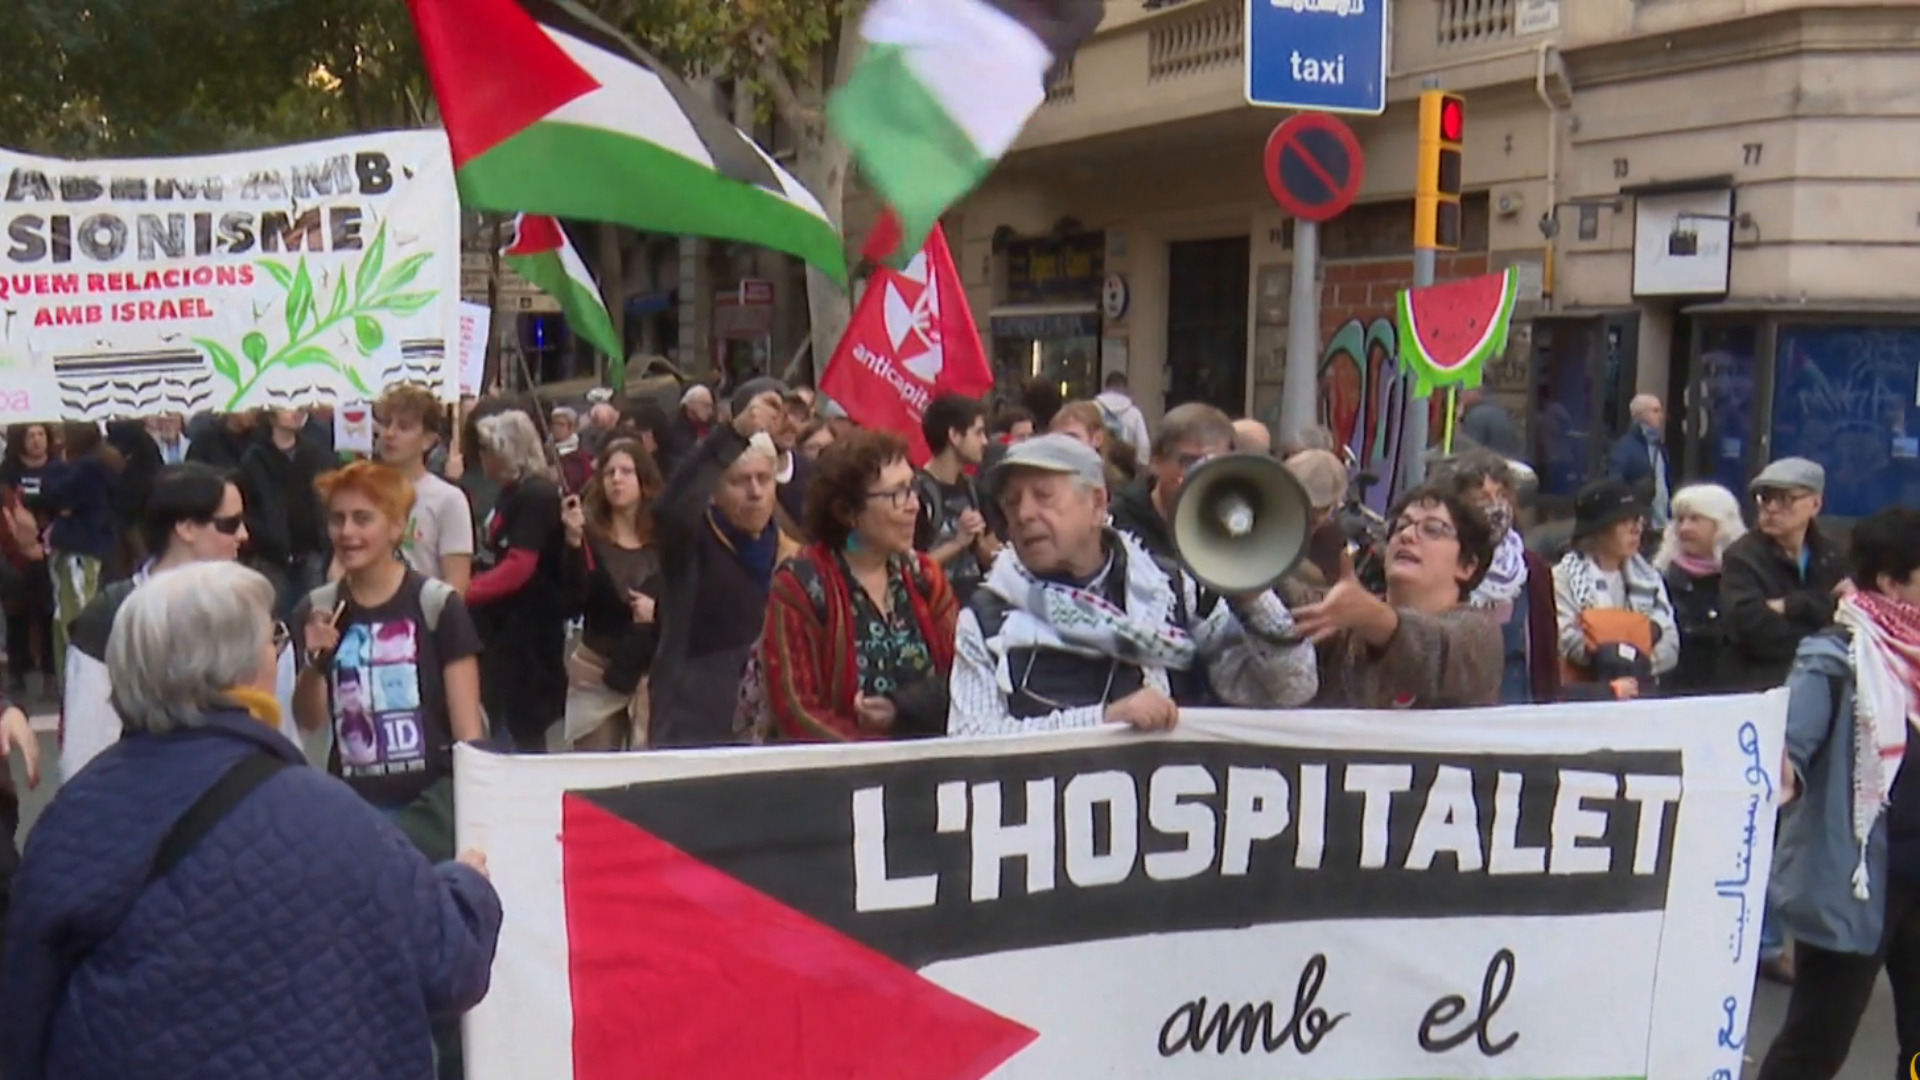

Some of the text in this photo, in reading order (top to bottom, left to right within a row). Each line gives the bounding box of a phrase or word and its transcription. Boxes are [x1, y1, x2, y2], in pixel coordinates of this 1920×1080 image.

[1290, 50, 1344, 84] taxi
[1742, 143, 1763, 165] 77
[240, 151, 393, 199] AMB
[7, 207, 364, 263] SIONISME
[87, 265, 255, 293] RELACIONS
[34, 298, 214, 327] AMB ISRAEL
[383, 718, 419, 752] 1D
[853, 764, 1683, 912] L'HOSPITALET
[1157, 948, 1519, 1057] amb el
